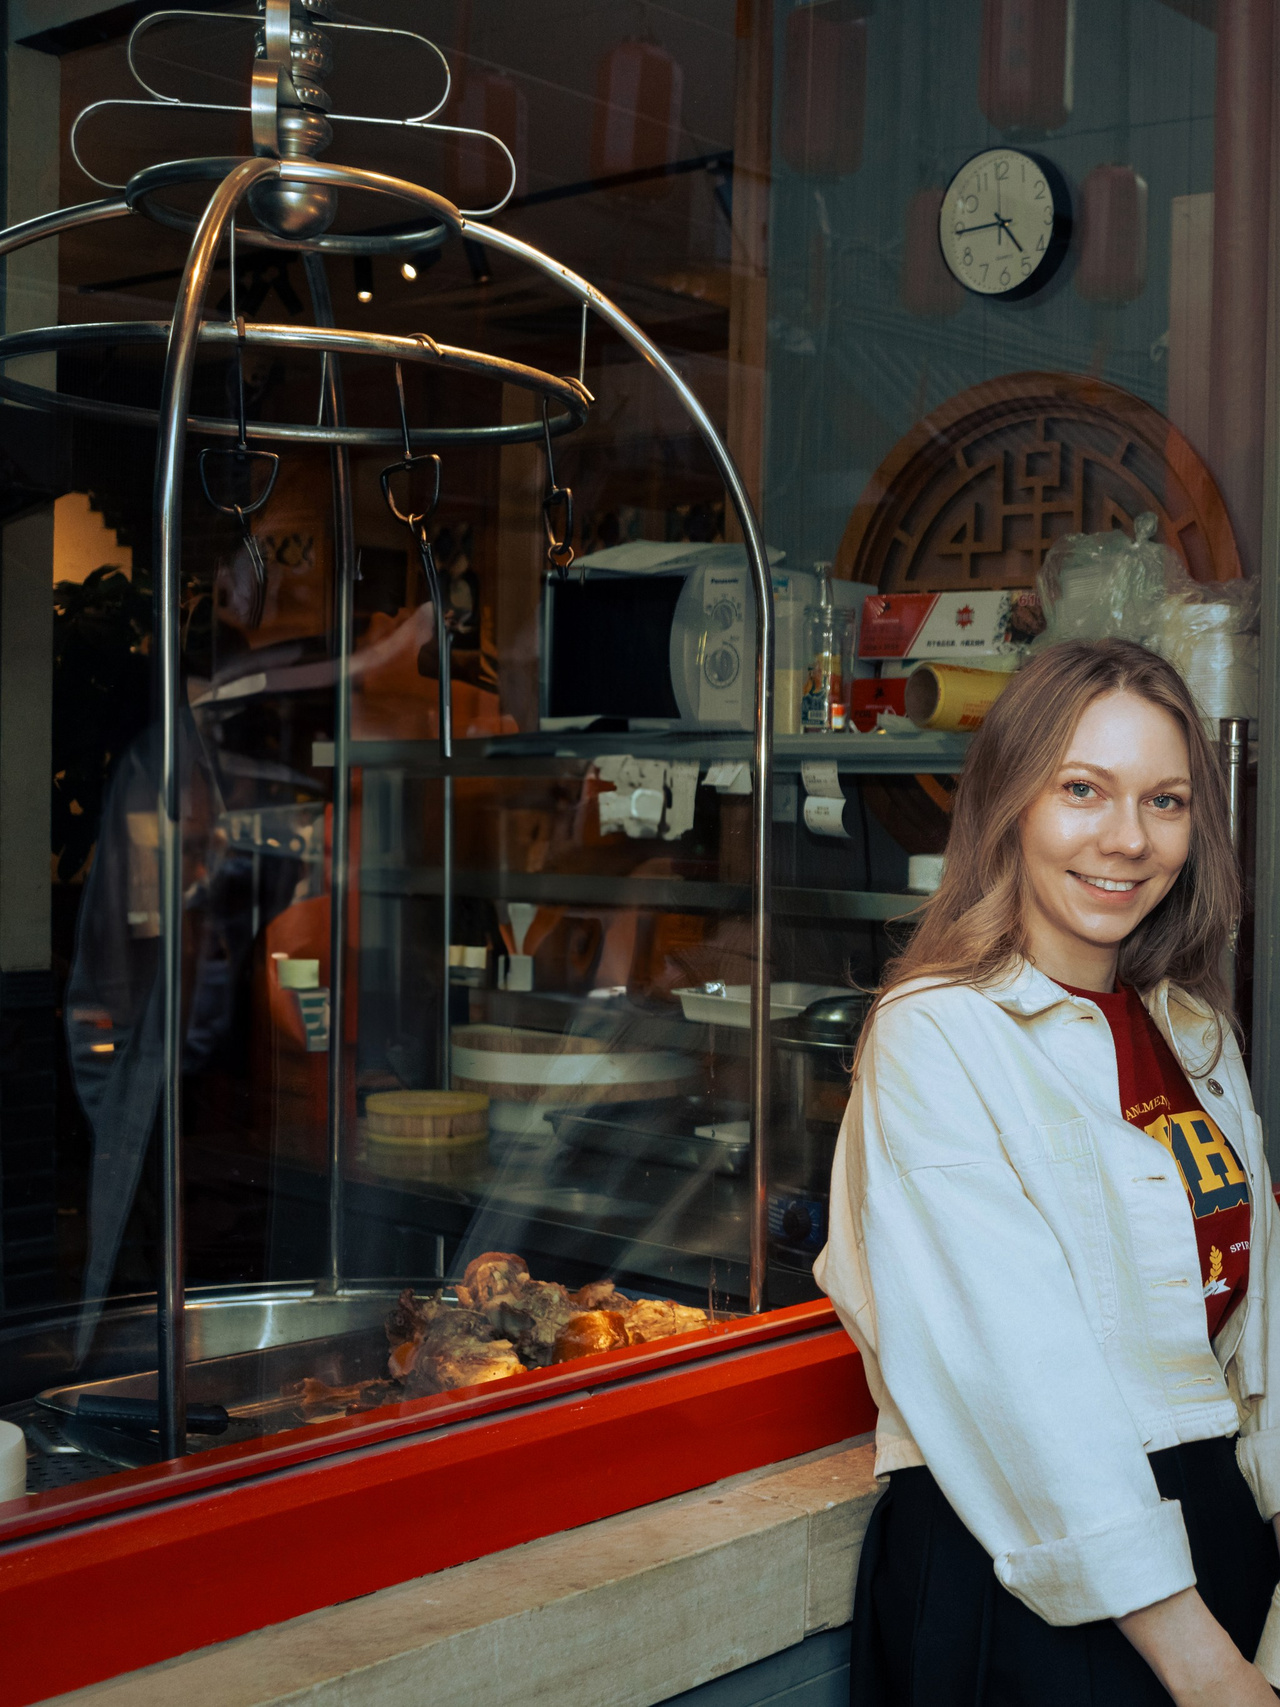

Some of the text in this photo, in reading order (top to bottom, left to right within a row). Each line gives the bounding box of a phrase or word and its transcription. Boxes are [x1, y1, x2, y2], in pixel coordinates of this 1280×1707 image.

[995, 161, 1010, 181] 12
[1021, 164, 1026, 183] 1
[976, 173, 988, 192] 11
[1034, 180, 1046, 200] 2
[1044, 206, 1054, 226] 3
[1036, 234, 1046, 252] 4
[963, 246, 974, 266] 8
[979, 263, 990, 282] 7
[1000, 266, 1011, 286] 6
[1021, 257, 1032, 276] 5
